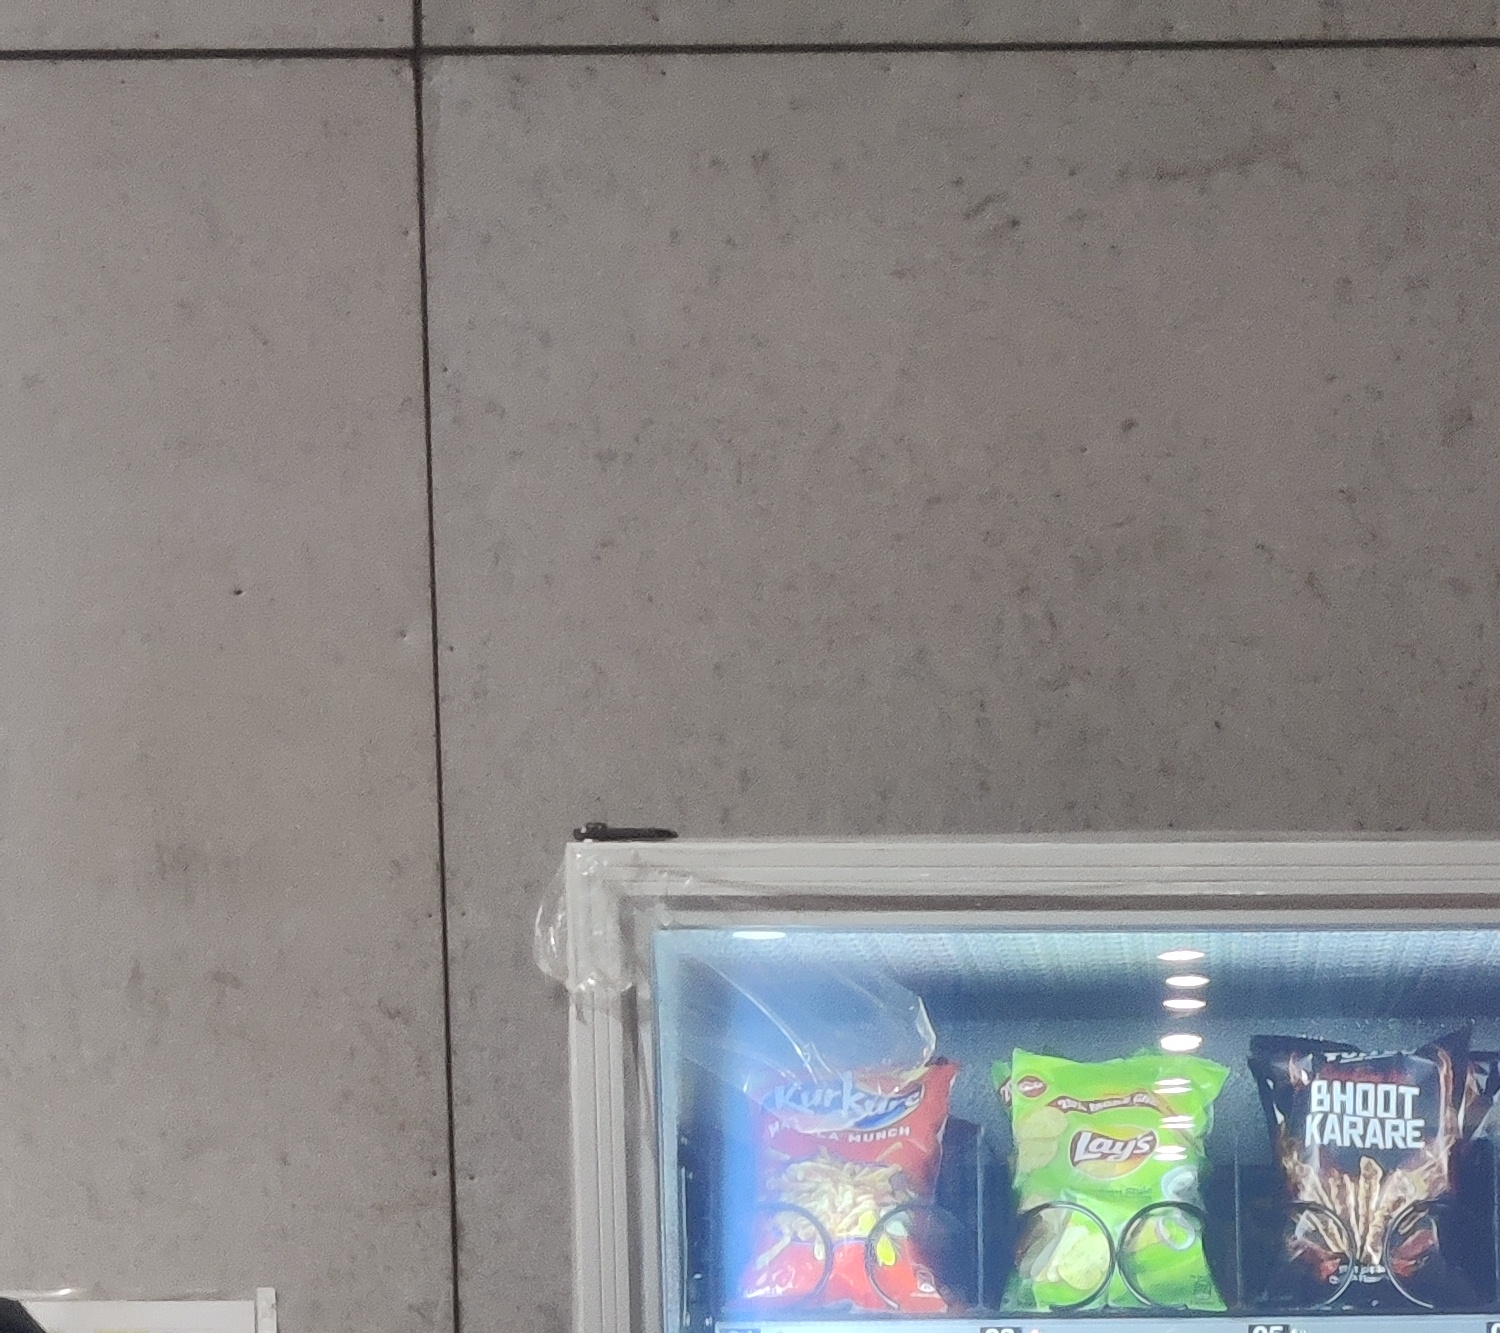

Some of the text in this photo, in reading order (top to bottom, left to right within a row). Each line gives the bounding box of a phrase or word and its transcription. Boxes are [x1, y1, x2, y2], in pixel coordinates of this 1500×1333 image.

[1311, 1080, 1420, 1119] BHOOT
[848, 1125, 911, 1143] MUNCH
[1305, 1113, 1425, 1149] KARARE
